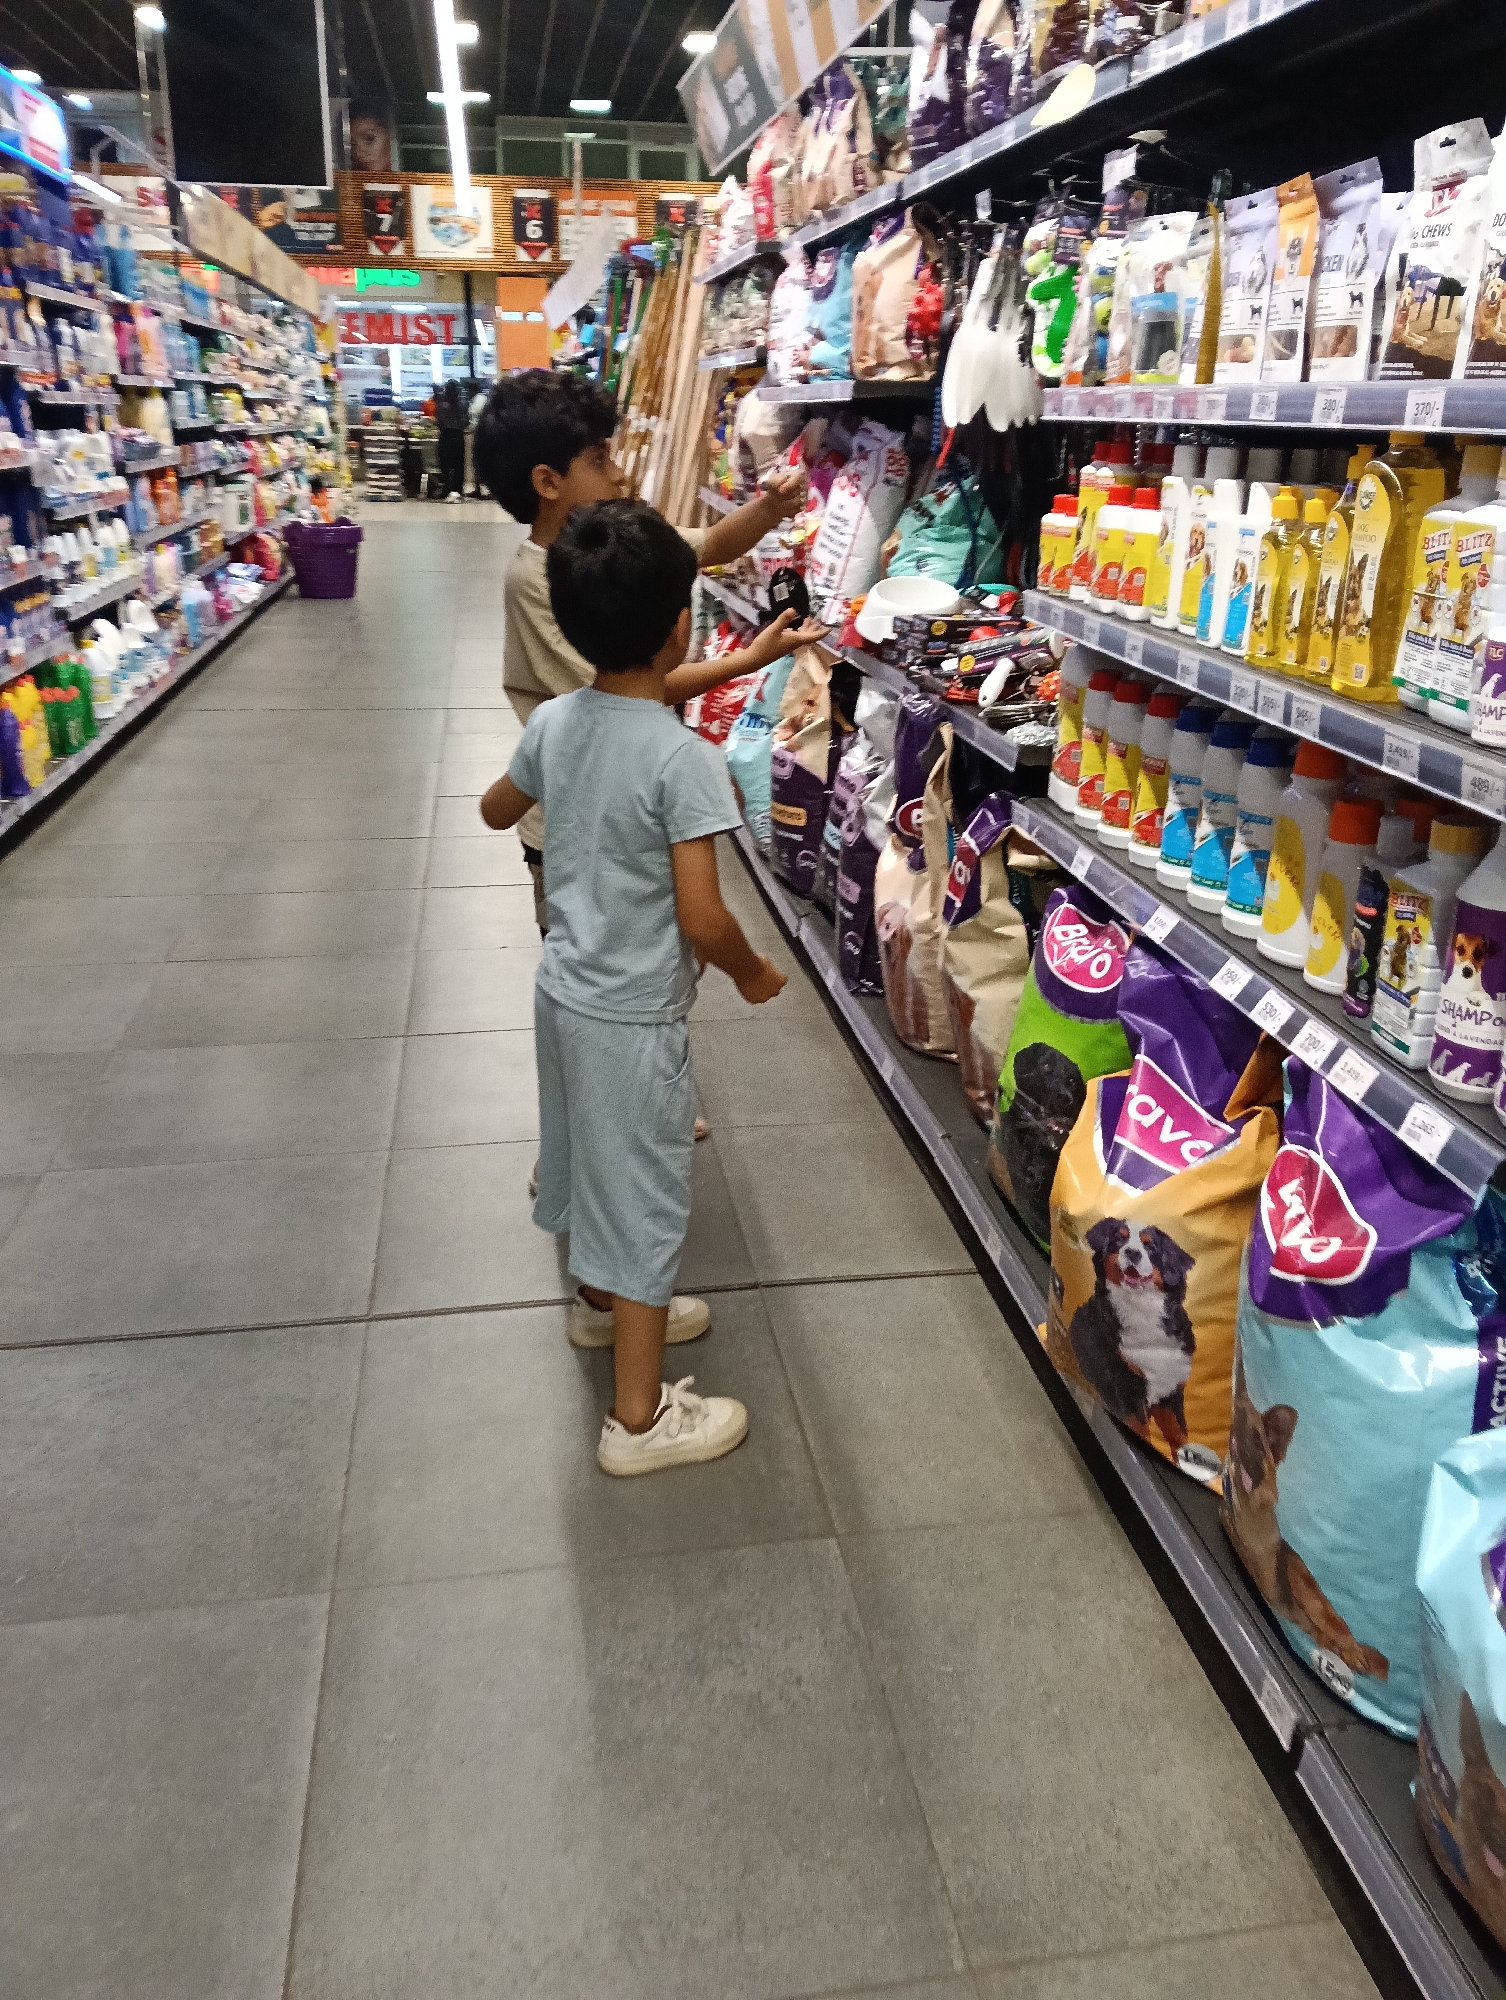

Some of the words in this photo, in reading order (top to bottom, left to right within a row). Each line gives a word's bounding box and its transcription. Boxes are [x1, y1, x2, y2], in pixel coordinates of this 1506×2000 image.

[525, 219, 544, 239] 6
[1422, 223, 1453, 238] CHEWS
[1414, 401, 1440, 417] 370/-
[1421, 532, 1452, 550] BLIT
[1456, 532, 1493, 553] BLITZ
[1303, 1032, 1327, 1055] 700/-
